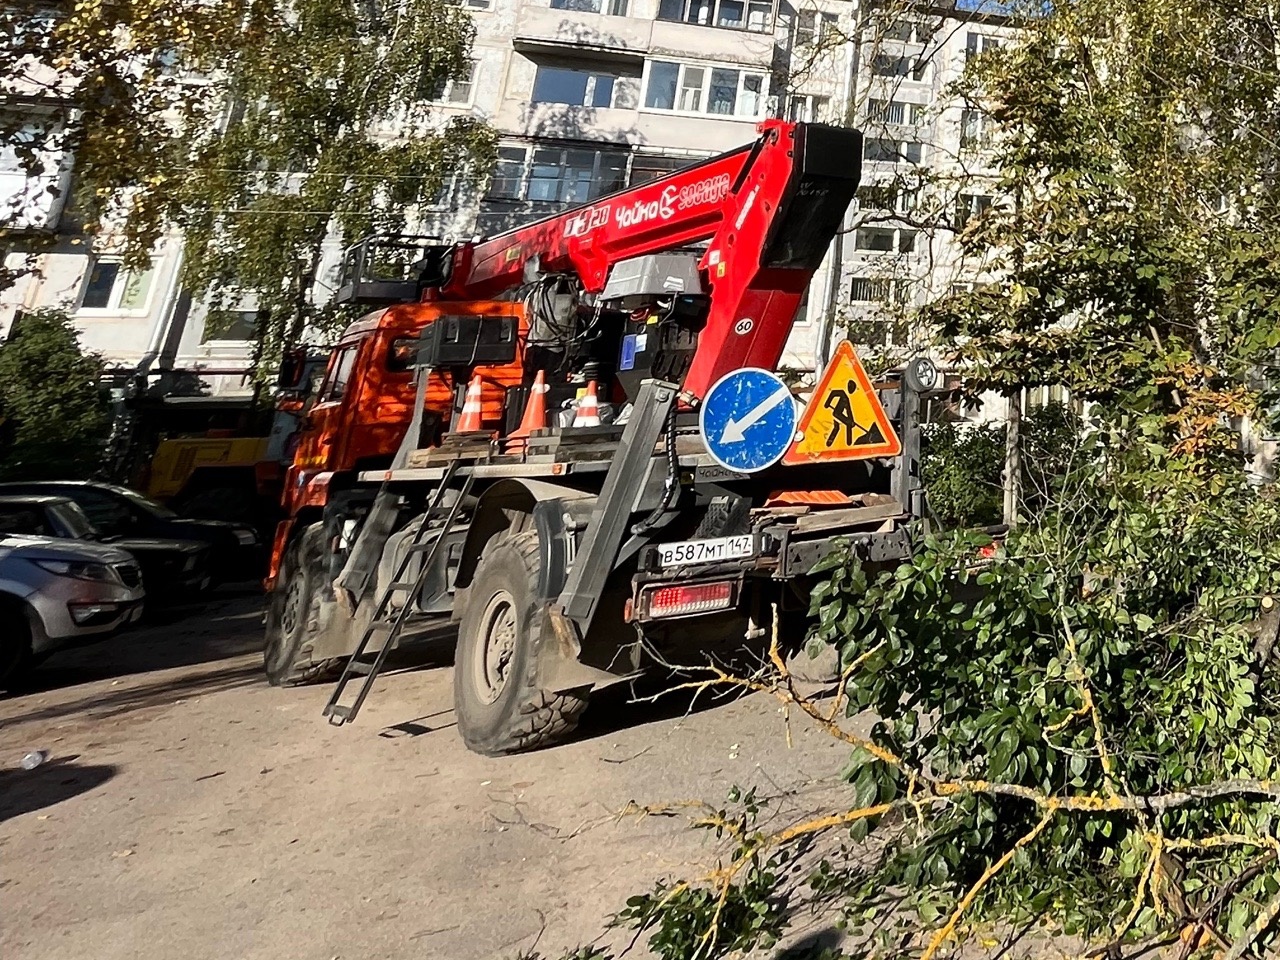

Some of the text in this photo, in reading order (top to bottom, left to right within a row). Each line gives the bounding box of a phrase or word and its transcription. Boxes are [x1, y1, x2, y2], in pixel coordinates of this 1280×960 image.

[737, 321, 752, 332] 60
[664, 537, 749, 563] В587МТ 147
